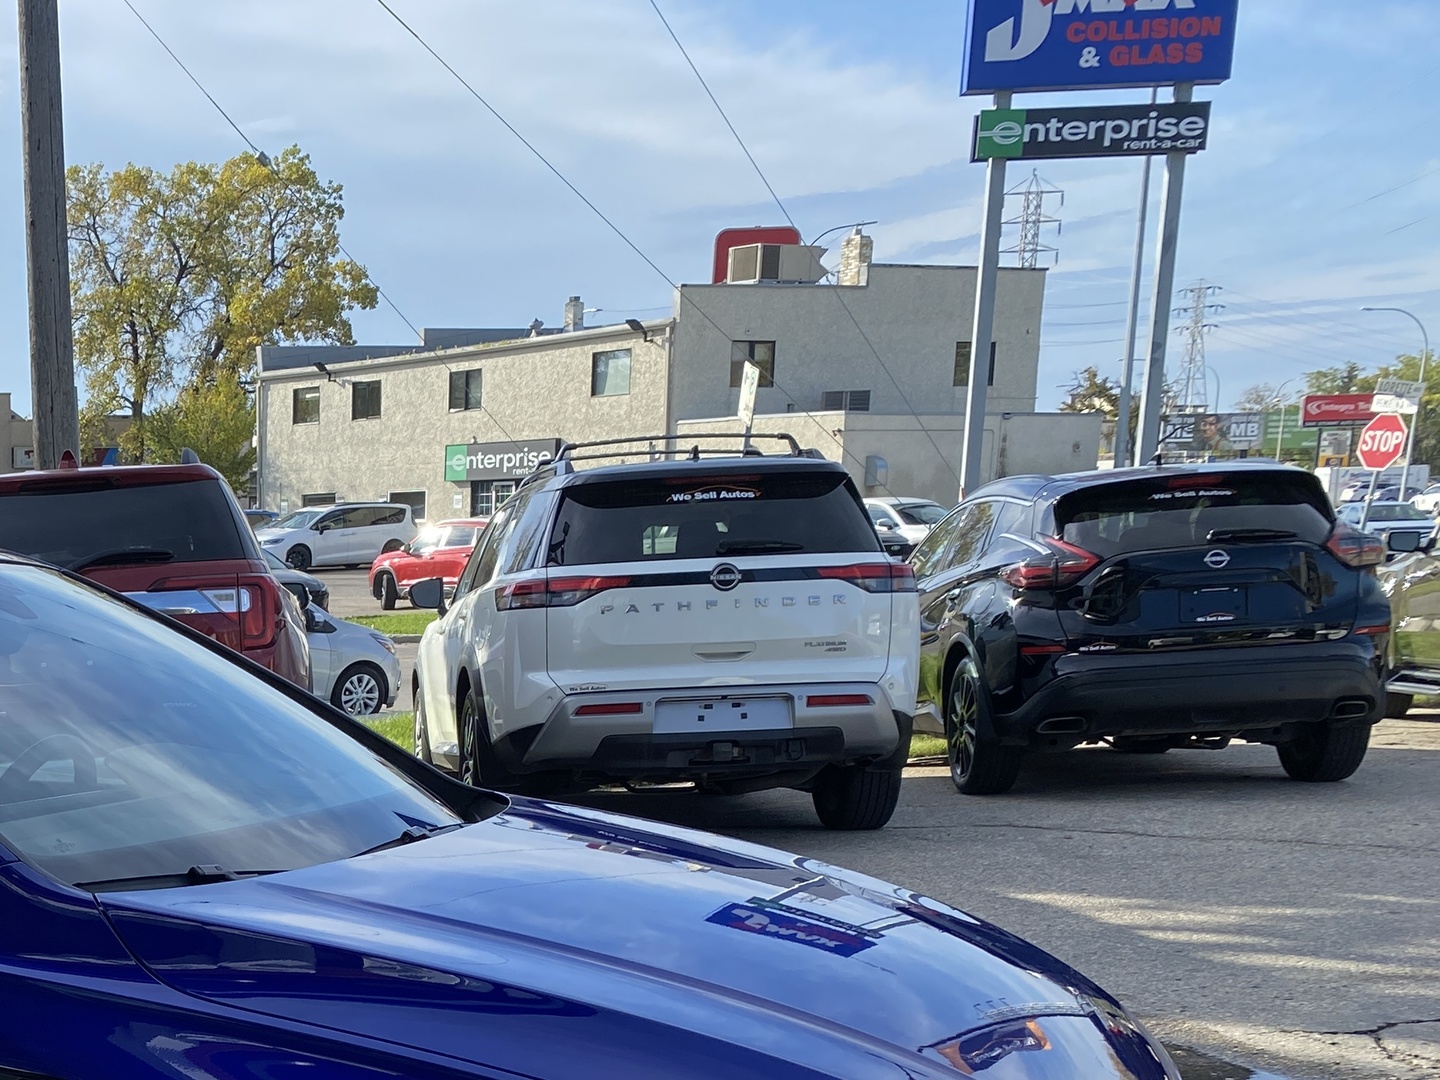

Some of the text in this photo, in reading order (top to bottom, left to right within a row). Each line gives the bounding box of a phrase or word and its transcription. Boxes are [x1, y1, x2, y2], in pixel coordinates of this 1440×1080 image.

[1066, 16, 1222, 43] COLLISION
[1079, 42, 1203, 68] & GLASS
[990, 110, 1206, 147] enterprise
[1123, 136, 1203, 150] rent-a-car
[1230, 422, 1259, 436] MB
[1361, 431, 1403, 452] STOP
[452, 447, 551, 473] enterprise
[671, 490, 755, 501] We Sell Autos
[600, 594, 847, 614] PATHFINDER
